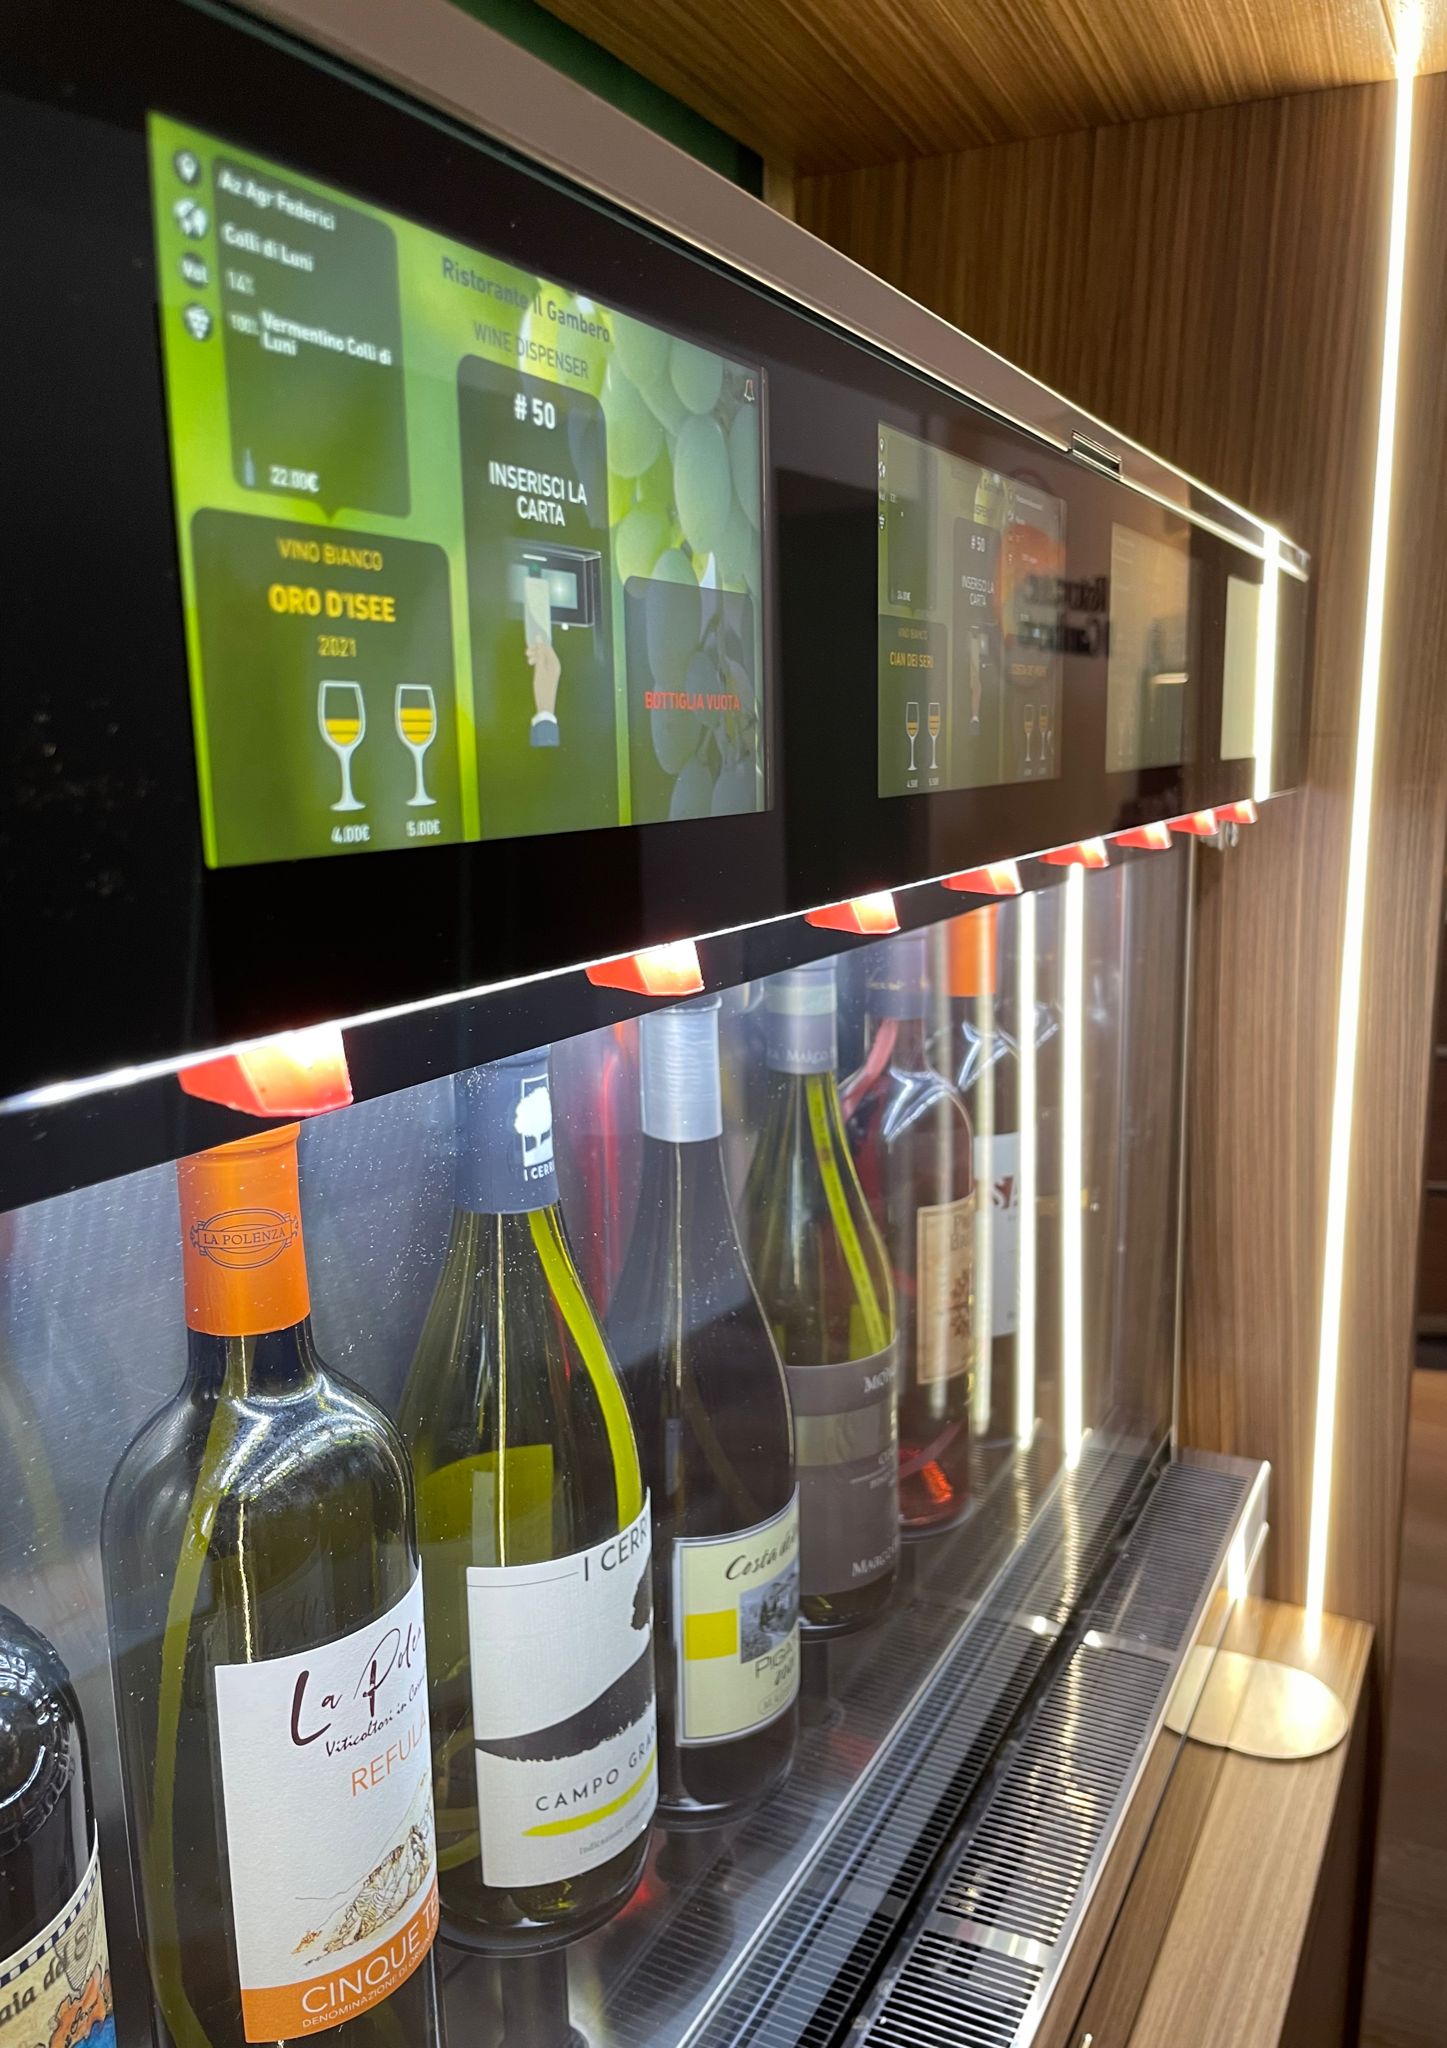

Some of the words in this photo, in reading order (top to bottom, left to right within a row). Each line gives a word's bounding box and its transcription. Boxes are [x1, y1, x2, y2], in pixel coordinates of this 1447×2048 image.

[277, 191, 336, 231] Federici
[223, 222, 260, 253] Colli
[263, 239, 279, 259] di
[281, 245, 314, 272] Luni
[442, 256, 529, 310] Ristorante
[533, 296, 543, 317] Il
[547, 300, 610, 342] Gambero
[261, 310, 346, 351] Vermentino
[347, 337, 377, 361] Colli
[379, 348, 392, 366] di
[263, 331, 298, 356] Luni
[473, 321, 512, 352] WINE
[517, 337, 589, 379] DISPENSER
[532, 400, 556, 429] 50
[489, 460, 565, 499] INSERISCI
[568, 482, 588, 505] LA
[516, 496, 566, 526] CARTA
[277, 537, 321, 563] VINO
[324, 543, 383, 571] BIANCO
[268, 583, 322, 615] ORO
[325, 590, 397, 622] D'ISEE
[317, 635, 357, 657] 2021
[644, 690, 705, 710] BOTTIGLIA
[706, 693, 741, 711] VUOTA
[330, 824, 370, 844] 4.00€
[405, 820, 440, 837] 5.00€
[524, 1169, 529, 1181] I
[204, 1233, 218, 1245] LA
[223, 1228, 286, 1245] POLENZA
[584, 1556, 589, 1582] I
[290, 1669, 343, 1746] La
[325, 1711, 393, 1757] Viticoltori
[535, 1767, 619, 1811] CAMPO
[301, 1920, 420, 2013] CINQUE
[302, 1976, 396, 2029] DENOMINAZIONE
